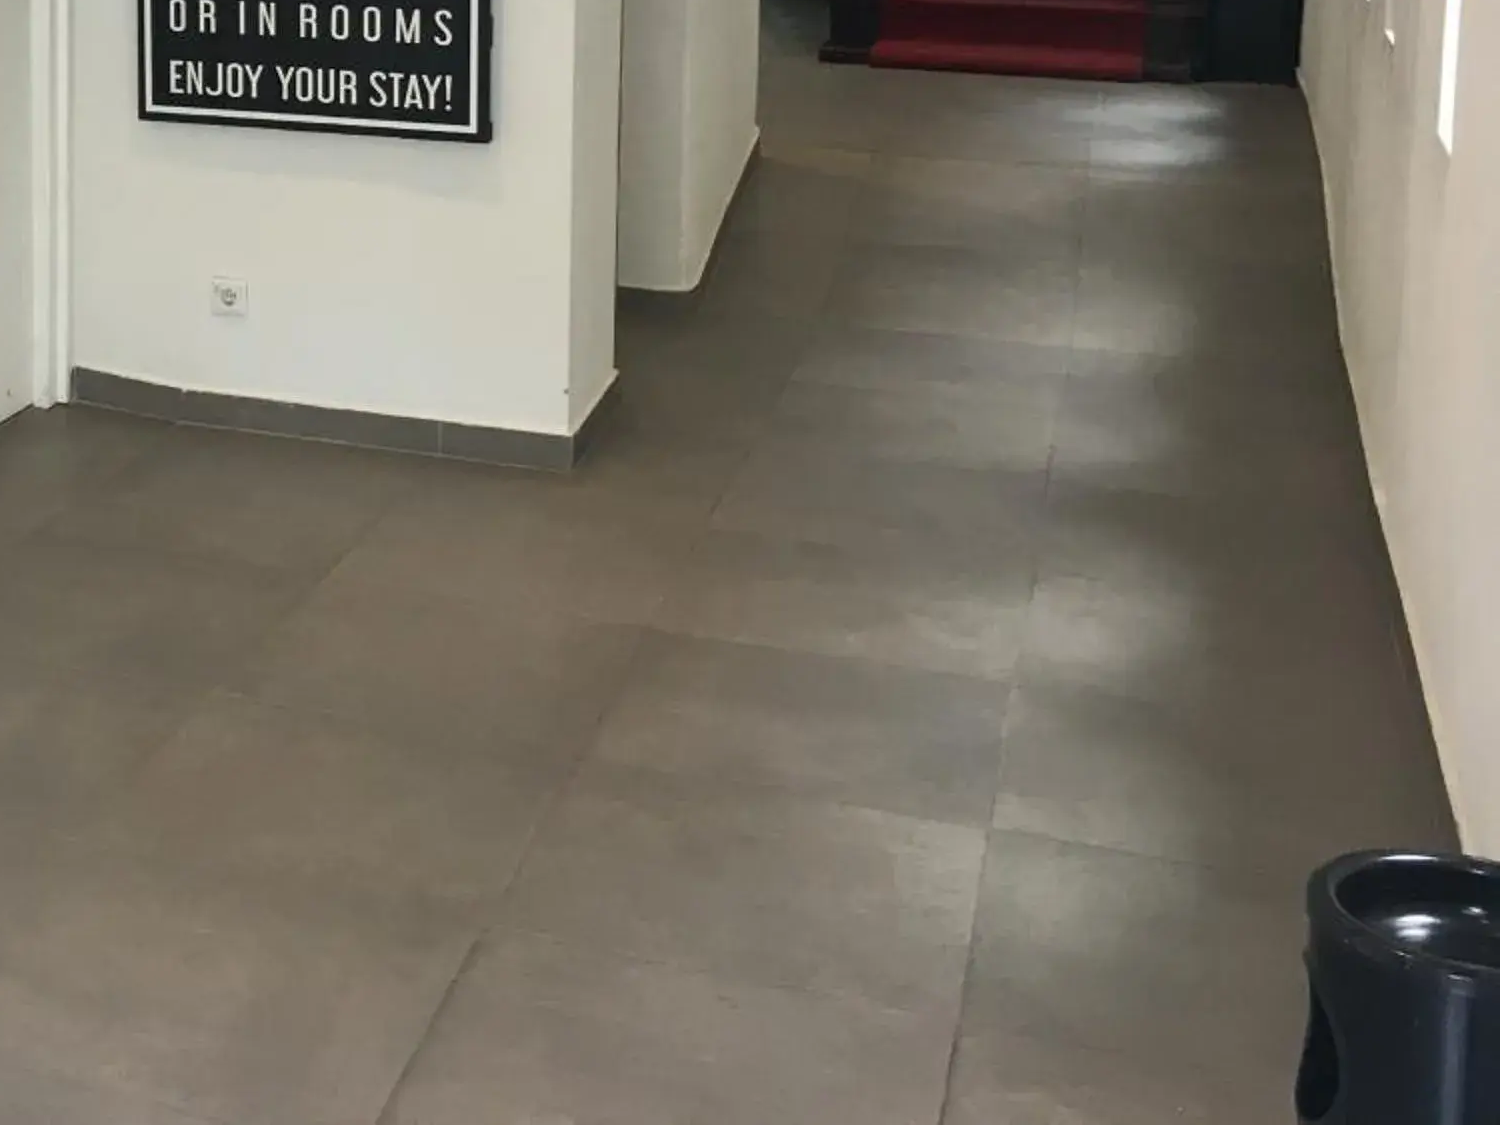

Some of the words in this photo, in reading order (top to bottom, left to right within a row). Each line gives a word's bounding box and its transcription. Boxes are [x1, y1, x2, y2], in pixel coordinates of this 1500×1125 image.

[240, 1, 276, 36] IN
[300, 4, 452, 45] ROOMS
[170, 60, 263, 98] ENJOY
[276, 66, 357, 104] YOUR
[370, 71, 452, 111] STAY!
